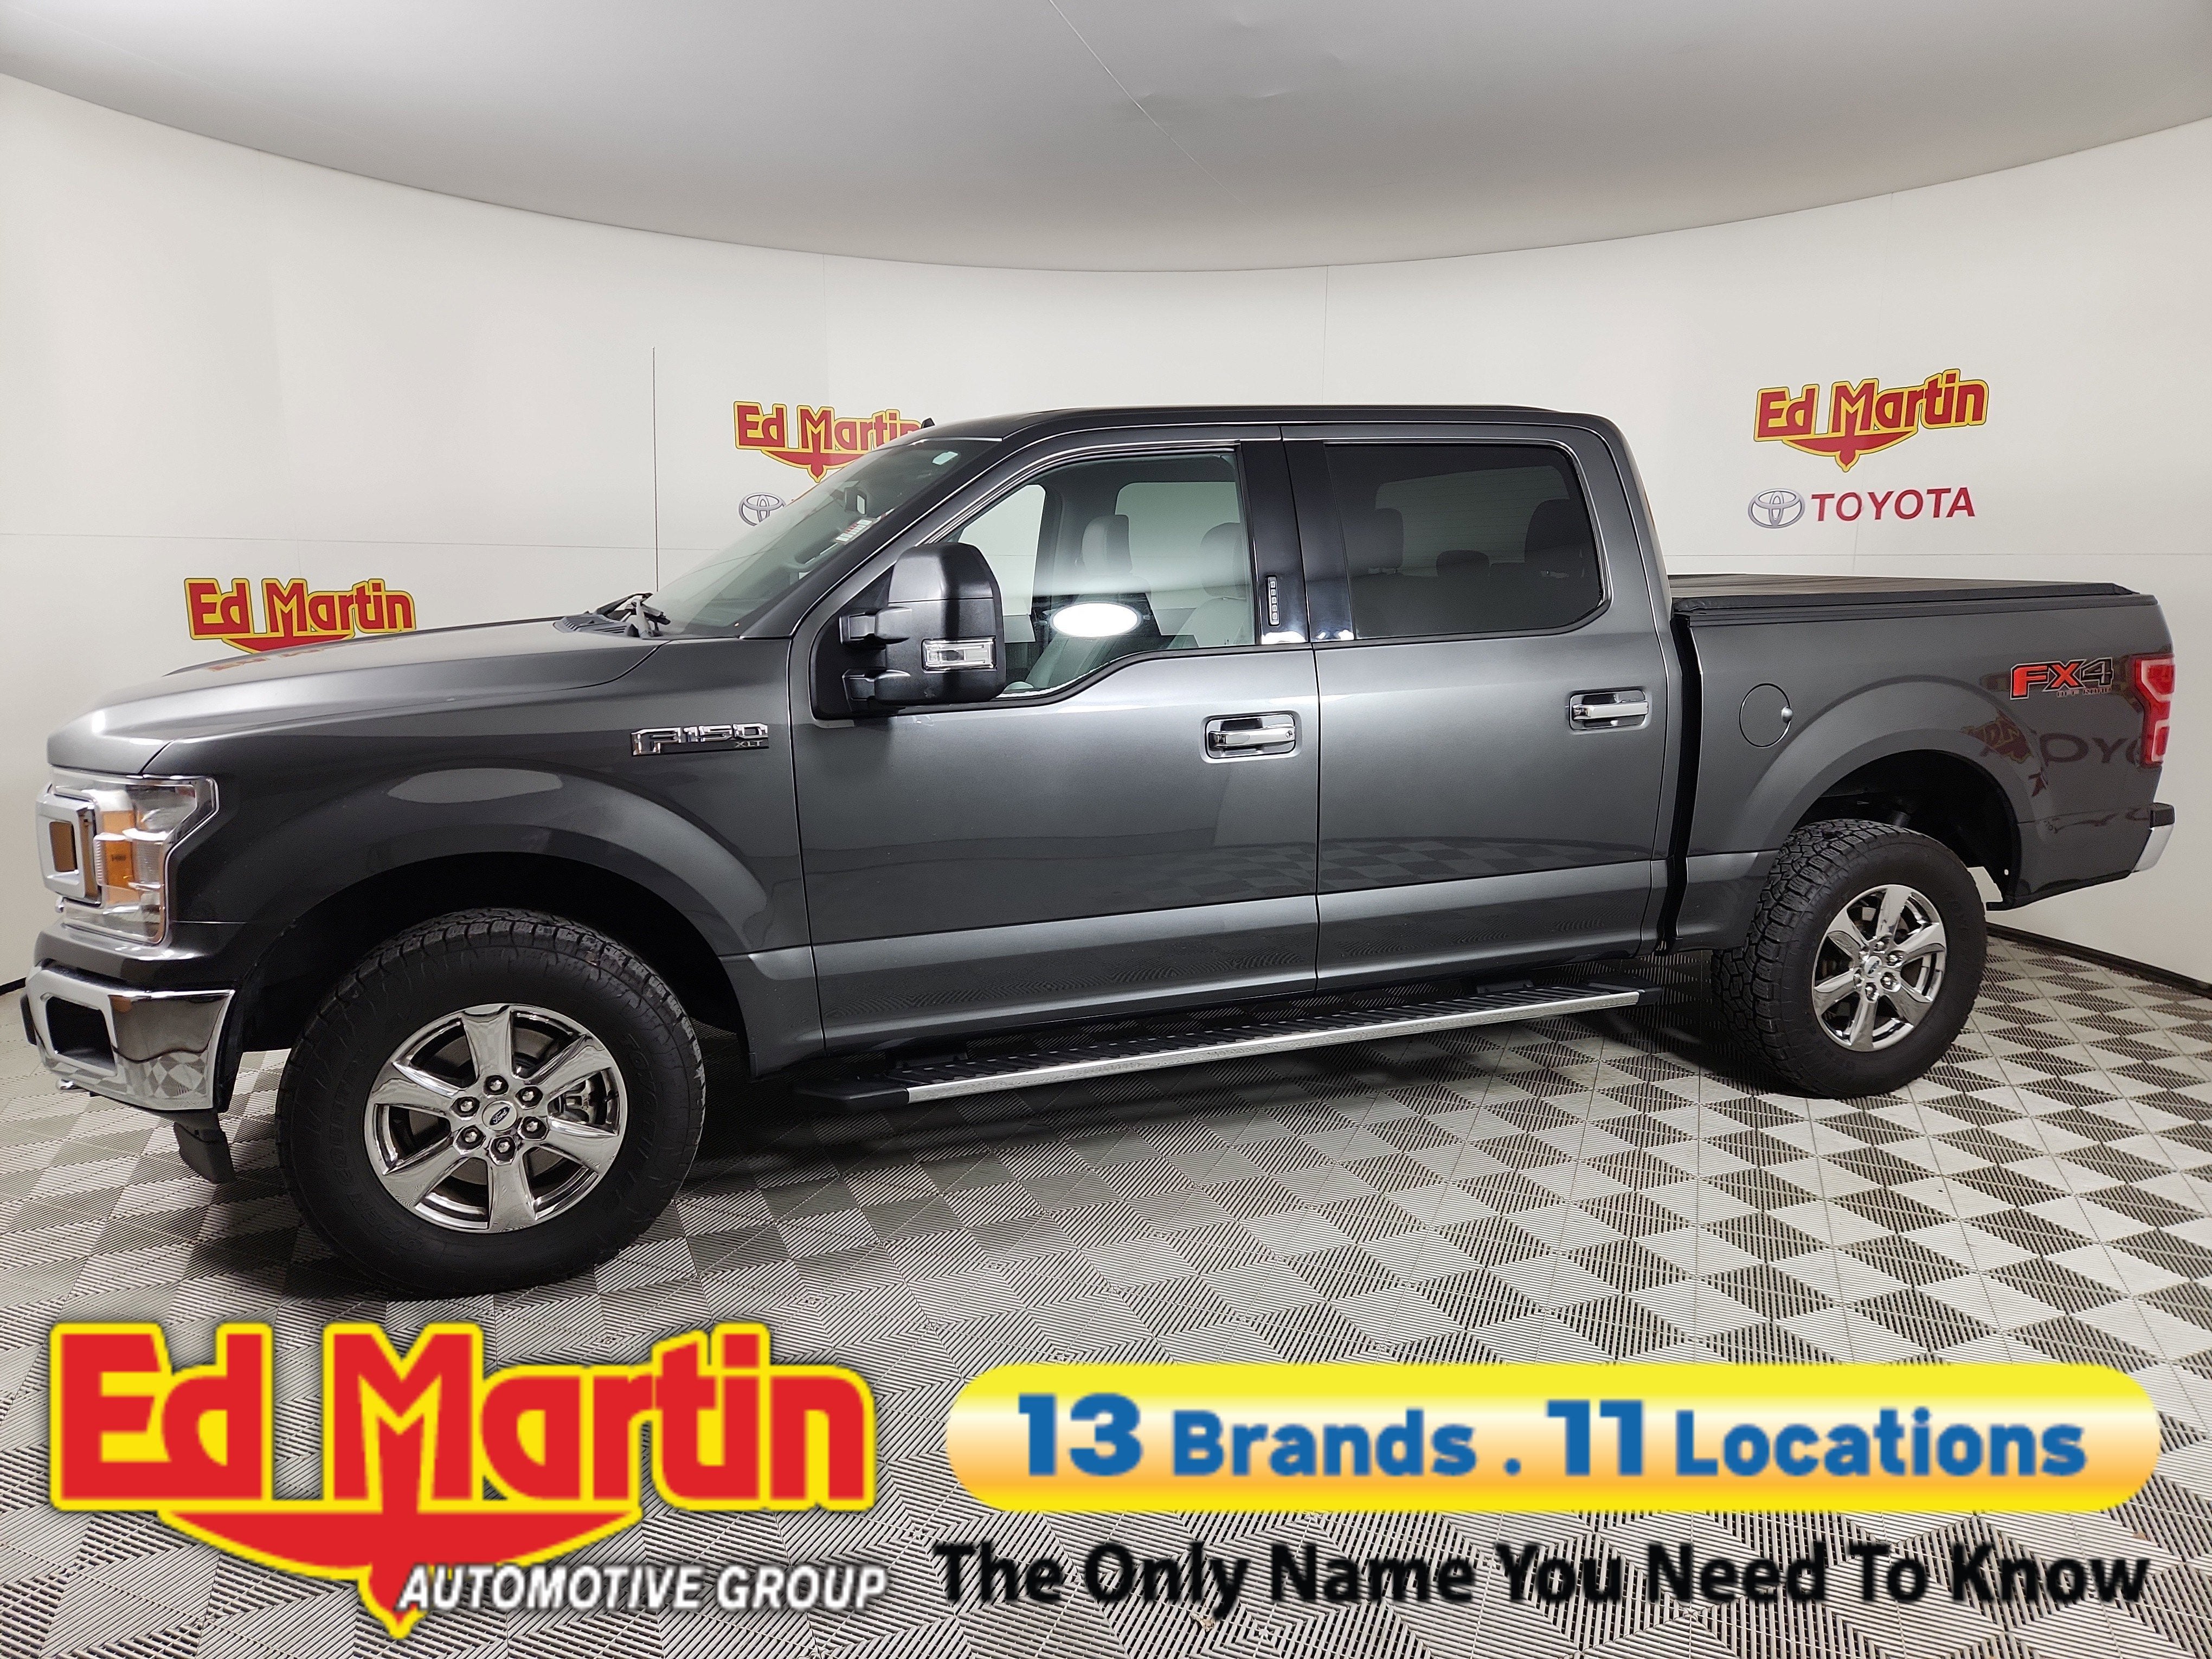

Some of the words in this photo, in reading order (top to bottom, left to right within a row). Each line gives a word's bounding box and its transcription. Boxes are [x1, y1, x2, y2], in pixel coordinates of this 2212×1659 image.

[734, 402, 787, 449] Ed
[1754, 384, 1819, 441] Ed
[1829, 369, 1989, 437] Martin
[1811, 487, 1976, 522] TOYOTA
[184, 578, 254, 639] Ed
[261, 578, 416, 638] Martin
[2010, 657, 2114, 700] FX4
[492, 1109, 508, 1124] Ford
